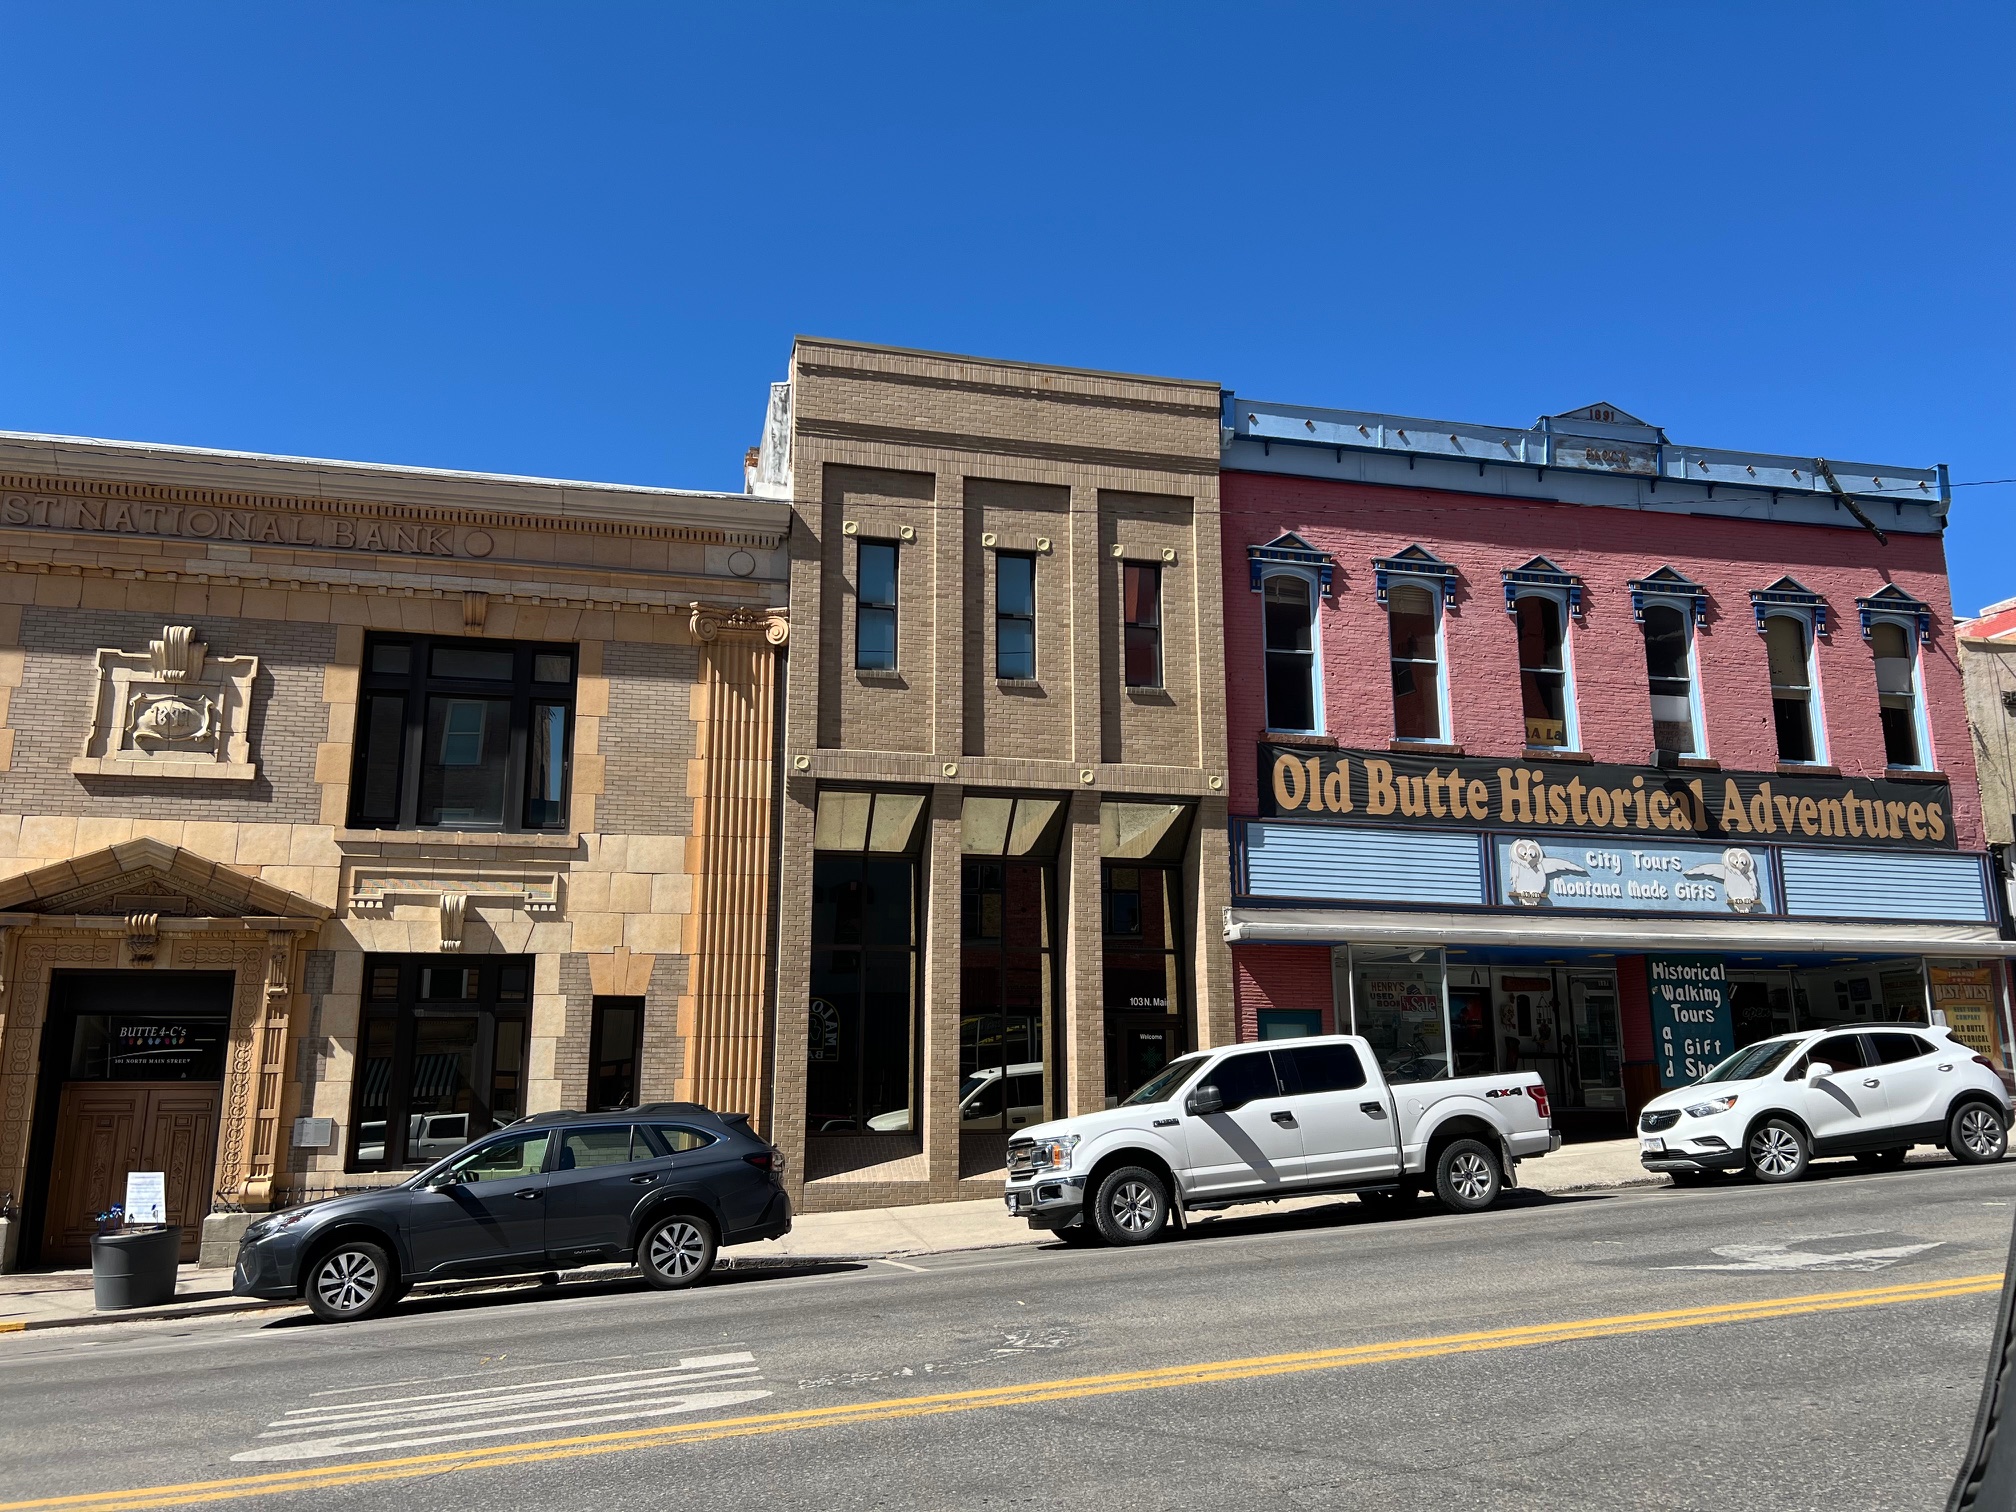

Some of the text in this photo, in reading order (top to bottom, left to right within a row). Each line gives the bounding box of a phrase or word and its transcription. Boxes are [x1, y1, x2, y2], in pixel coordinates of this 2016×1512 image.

[1589, 408, 1615, 422] 1891
[72, 500, 316, 546] NATIONAL
[328, 519, 454, 556] BANK
[1272, 753, 1946, 842] Old Butte Historical Adventures
[1585, 850, 1683, 875] City Tours
[1652, 961, 1726, 981] Historical
[1371, 981, 1406, 992] HENRY'S
[1660, 983, 1722, 1008] Walking
[1933, 984, 1960, 1003] BEST
[1962, 984, 1992, 1003] WEST
[1129, 997, 1144, 1006] 103
[1145, 997, 1152, 1006] N.
[1411, 996, 1436, 1012] Sale
[1670, 1003, 1715, 1023] Tours
[119, 1026, 187, 1037] BUTTE 4-C's
[1966, 1025, 1986, 1033] BUTTE
[1957, 1035, 1989, 1043] STORICAL
[1685, 1057, 1716, 1078] Sho
